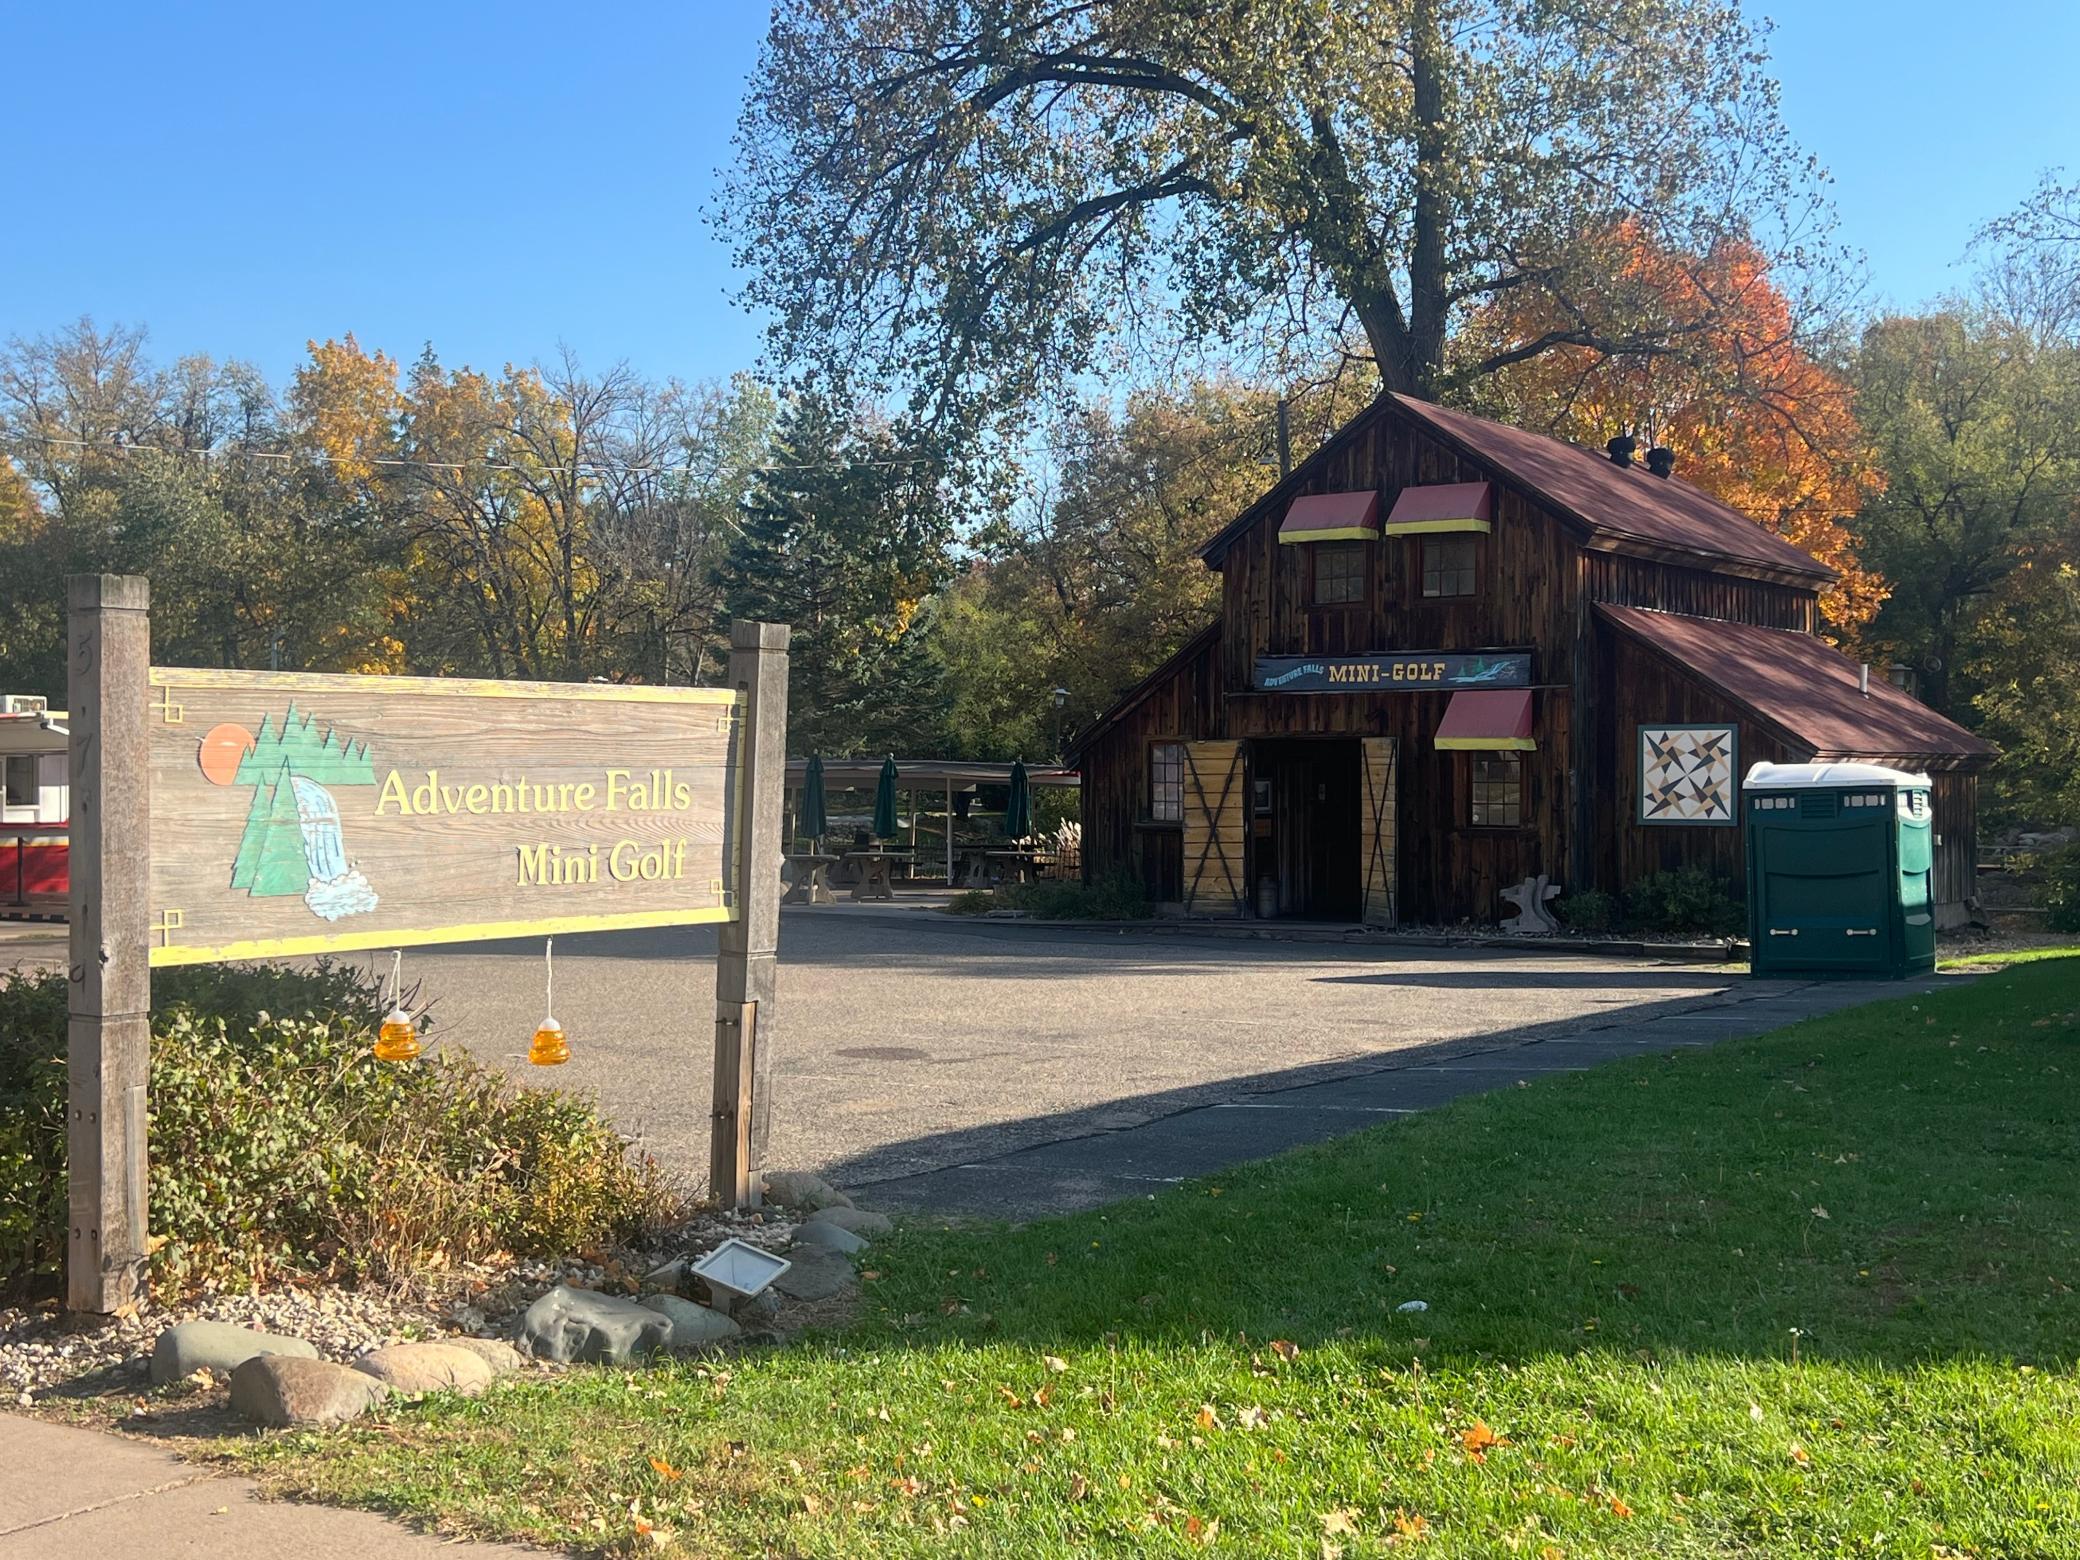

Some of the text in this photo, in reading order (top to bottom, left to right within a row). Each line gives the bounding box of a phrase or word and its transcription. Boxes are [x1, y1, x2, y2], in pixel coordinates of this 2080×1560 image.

[1264, 664, 1325, 687] ADVENTURE FALLS
[1328, 663, 1446, 683] MINI-GOLF
[374, 768, 691, 816] Adventure Falls
[516, 837, 689, 887] Mini Golf
